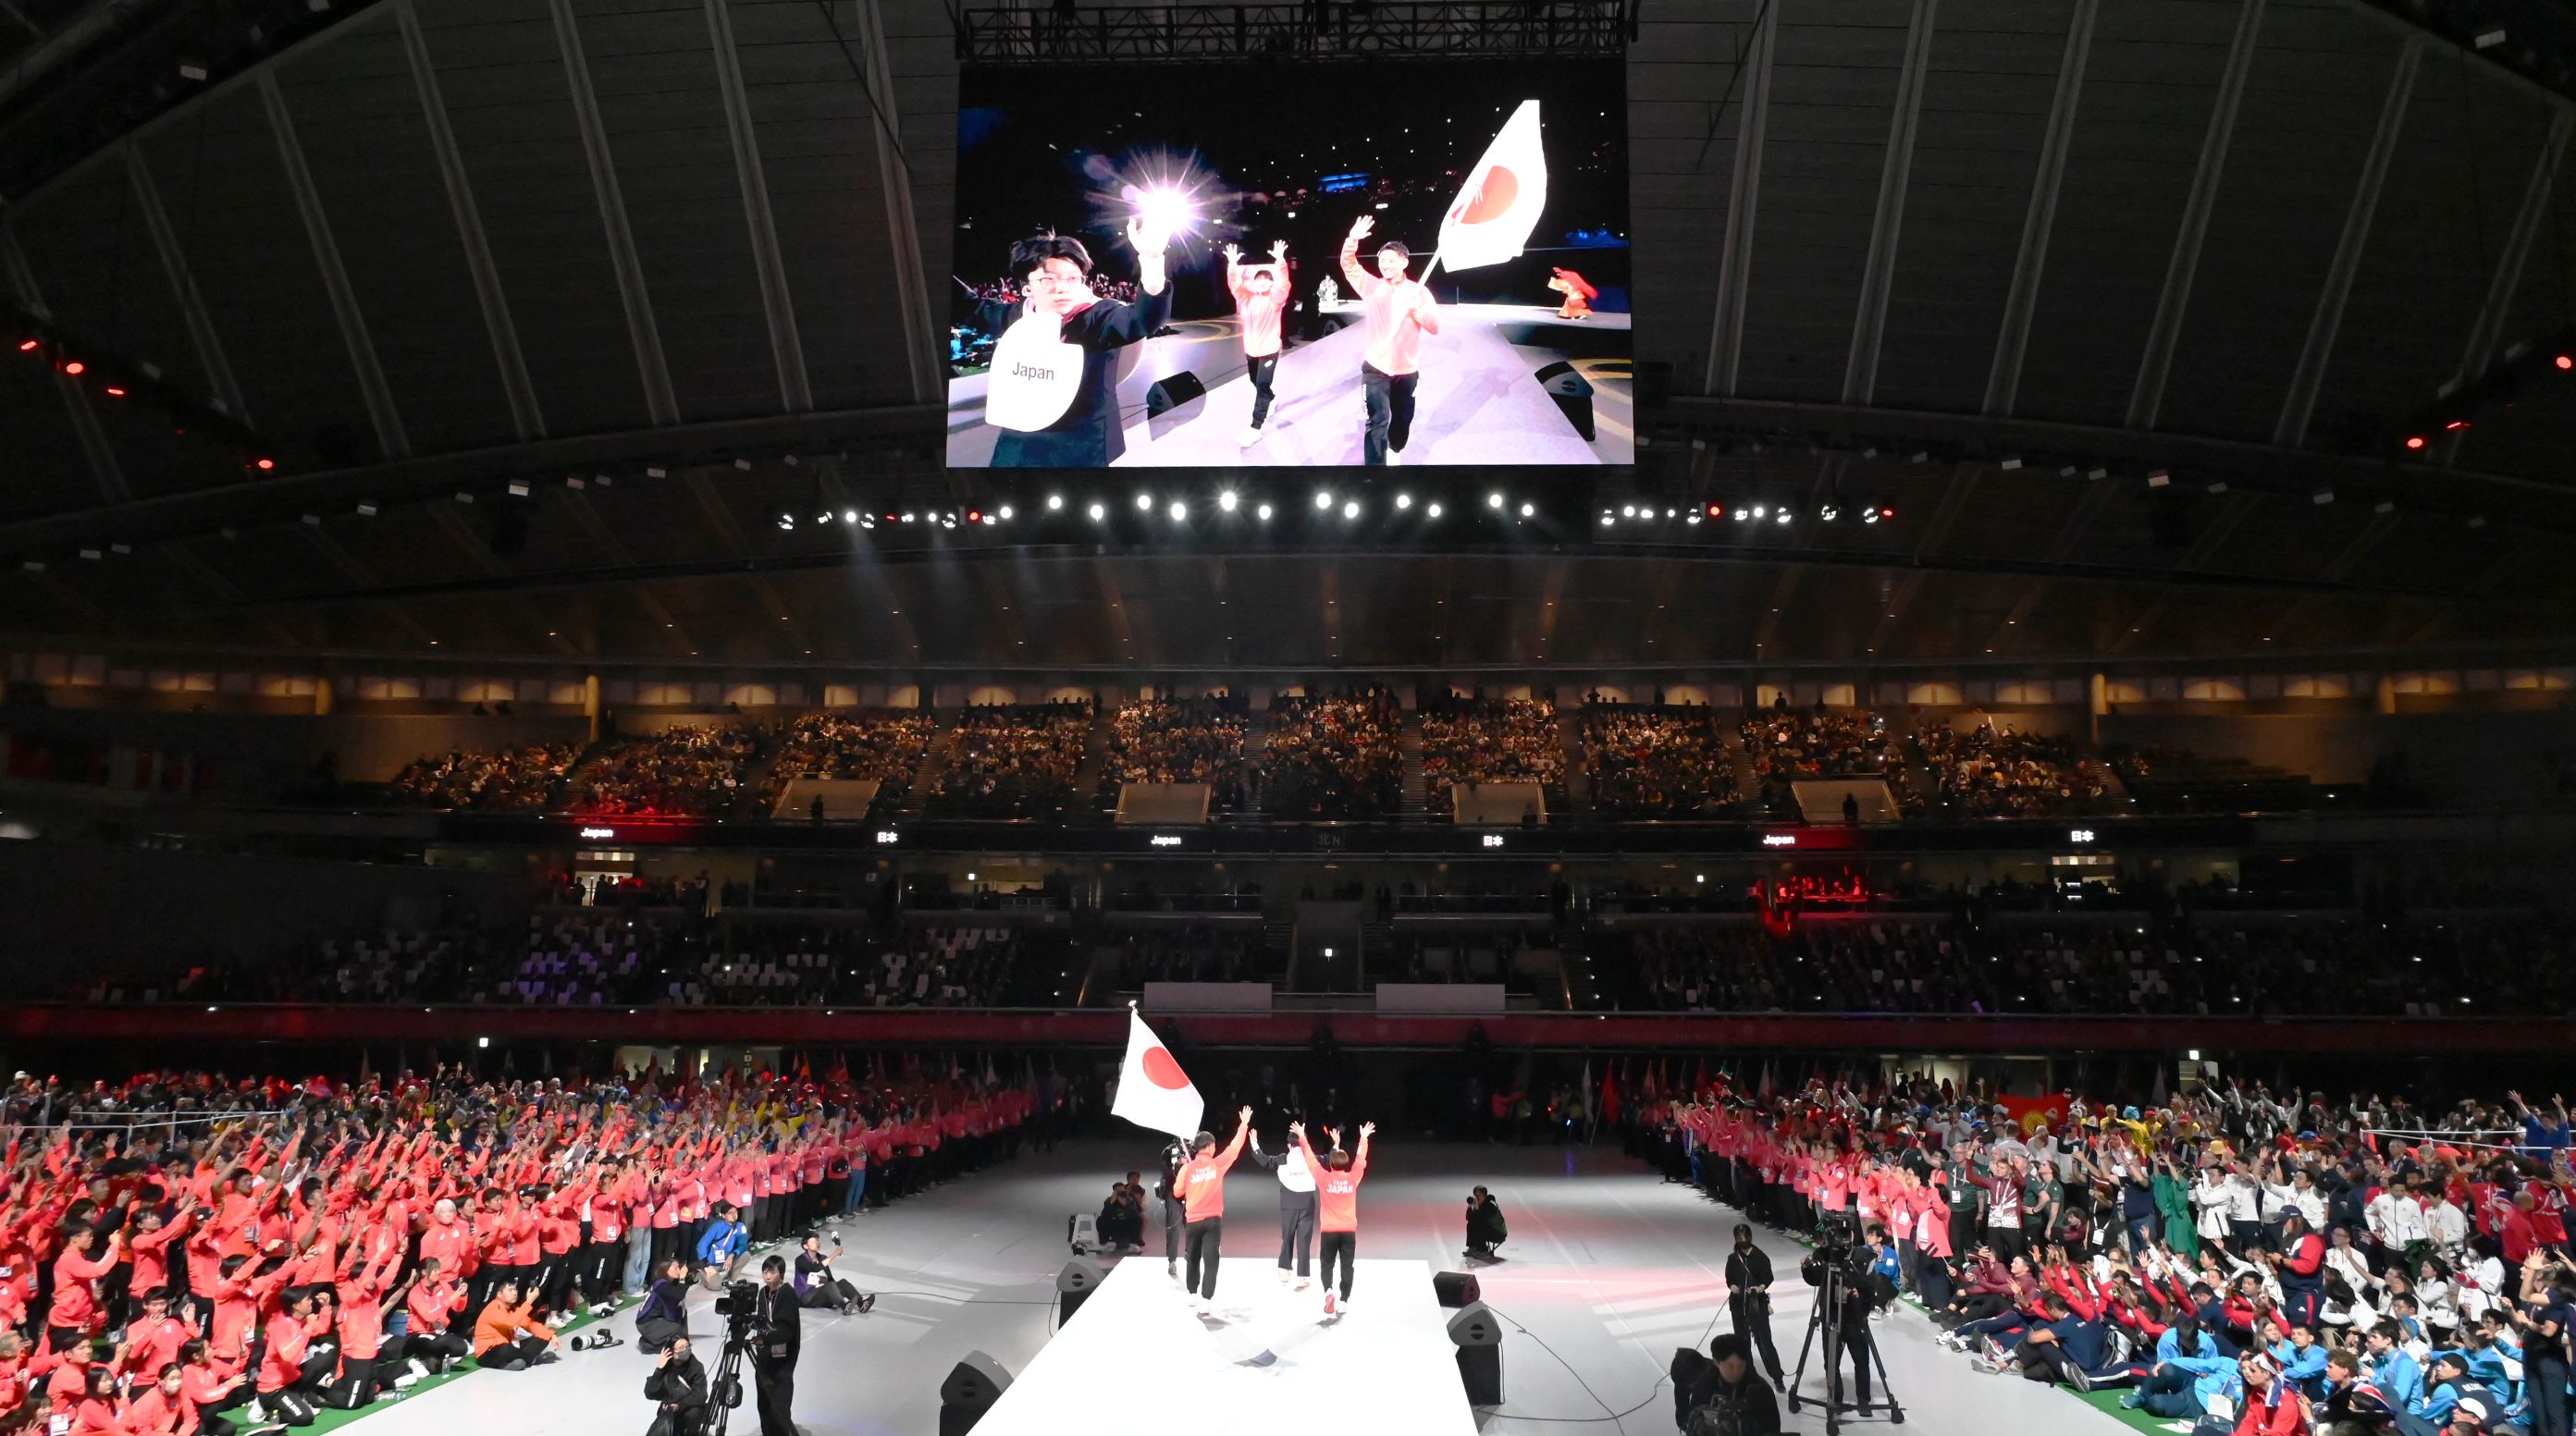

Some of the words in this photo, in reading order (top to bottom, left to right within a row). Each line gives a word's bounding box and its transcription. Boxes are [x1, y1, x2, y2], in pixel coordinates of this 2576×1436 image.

[1012, 362, 1054, 381] Japan
[580, 827, 614, 839] Japan
[877, 831, 898, 843] 日本
[2071, 829, 2095, 842] 日本
[1151, 834, 1182, 847] Japan
[1483, 835, 1504, 847] 日本
[1762, 834, 1795, 846] Japan
[1189, 1170, 1217, 1184] JAPAN
[1325, 1184, 1353, 1195] JAPAN
